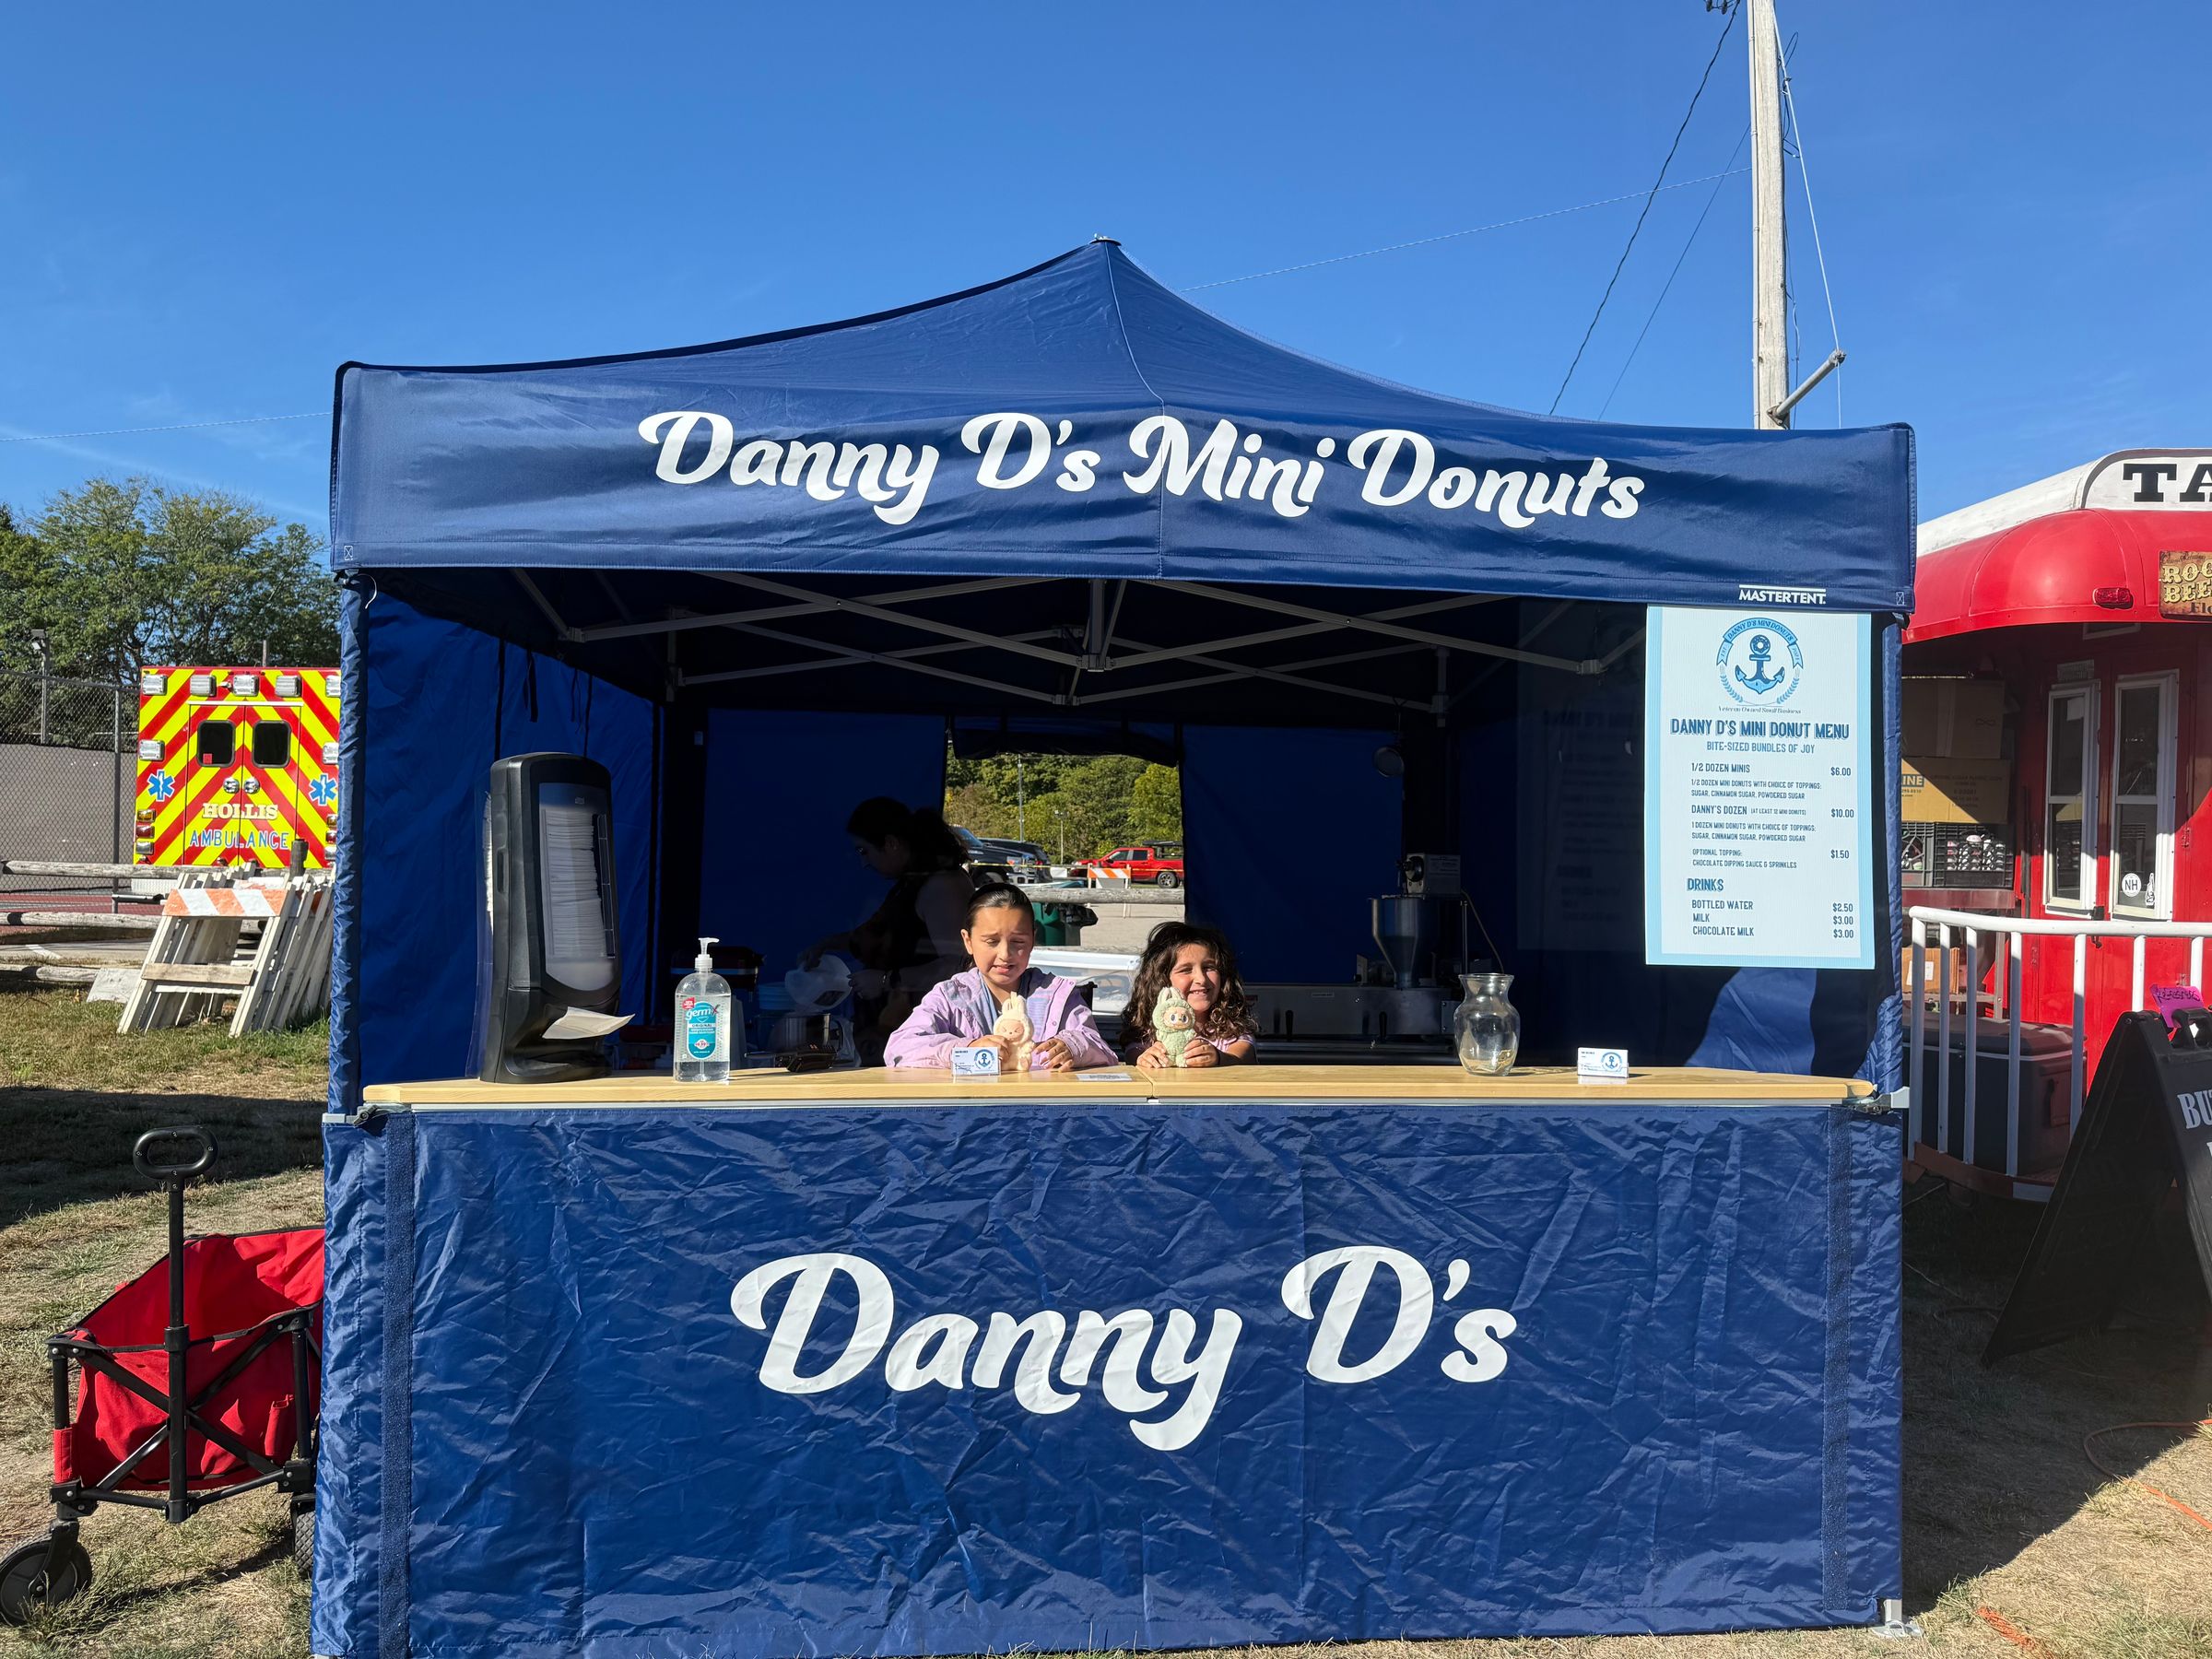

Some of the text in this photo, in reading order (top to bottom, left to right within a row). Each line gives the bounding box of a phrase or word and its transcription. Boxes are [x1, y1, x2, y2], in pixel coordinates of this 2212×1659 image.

[638, 410, 1645, 529] Danny D's Mini Donuts
[1728, 622, 1746, 640] DANNY
[1758, 619, 1771, 628] MINI
[1771, 622, 1794, 641] DONUTS
[1670, 718, 1849, 739] DANNY D'S MINI DONUT MENU
[1707, 742, 1815, 753] BITE-SIZED BUNDLES OF JOY
[1692, 763, 1750, 772] 1/2 DOZEN MINIS
[1831, 767, 1851, 776] $6.00
[202, 803, 278, 819] HOLLIS
[1691, 805, 1722, 814] DANNY'S
[1724, 806, 1747, 815] DOZEN
[1831, 808, 1854, 818] $10.00
[190, 830, 289, 849] AMBULANCE
[1831, 849, 1849, 859] $1.50
[1688, 878, 1724, 892] DRINKS
[2125, 879, 2137, 890] NH
[1692, 900, 1753, 910] BOTTLED WATER
[1833, 902, 1853, 912] $2.50
[1693, 913, 1710, 922] MILK
[1833, 915, 1853, 924] $3.00
[1693, 926, 1754, 936] CHOCOLATE MILK
[1833, 929, 1853, 938] $3.00
[2177, 1089, 2212, 1129] BU
[730, 1245, 1517, 1452] Danny D's
